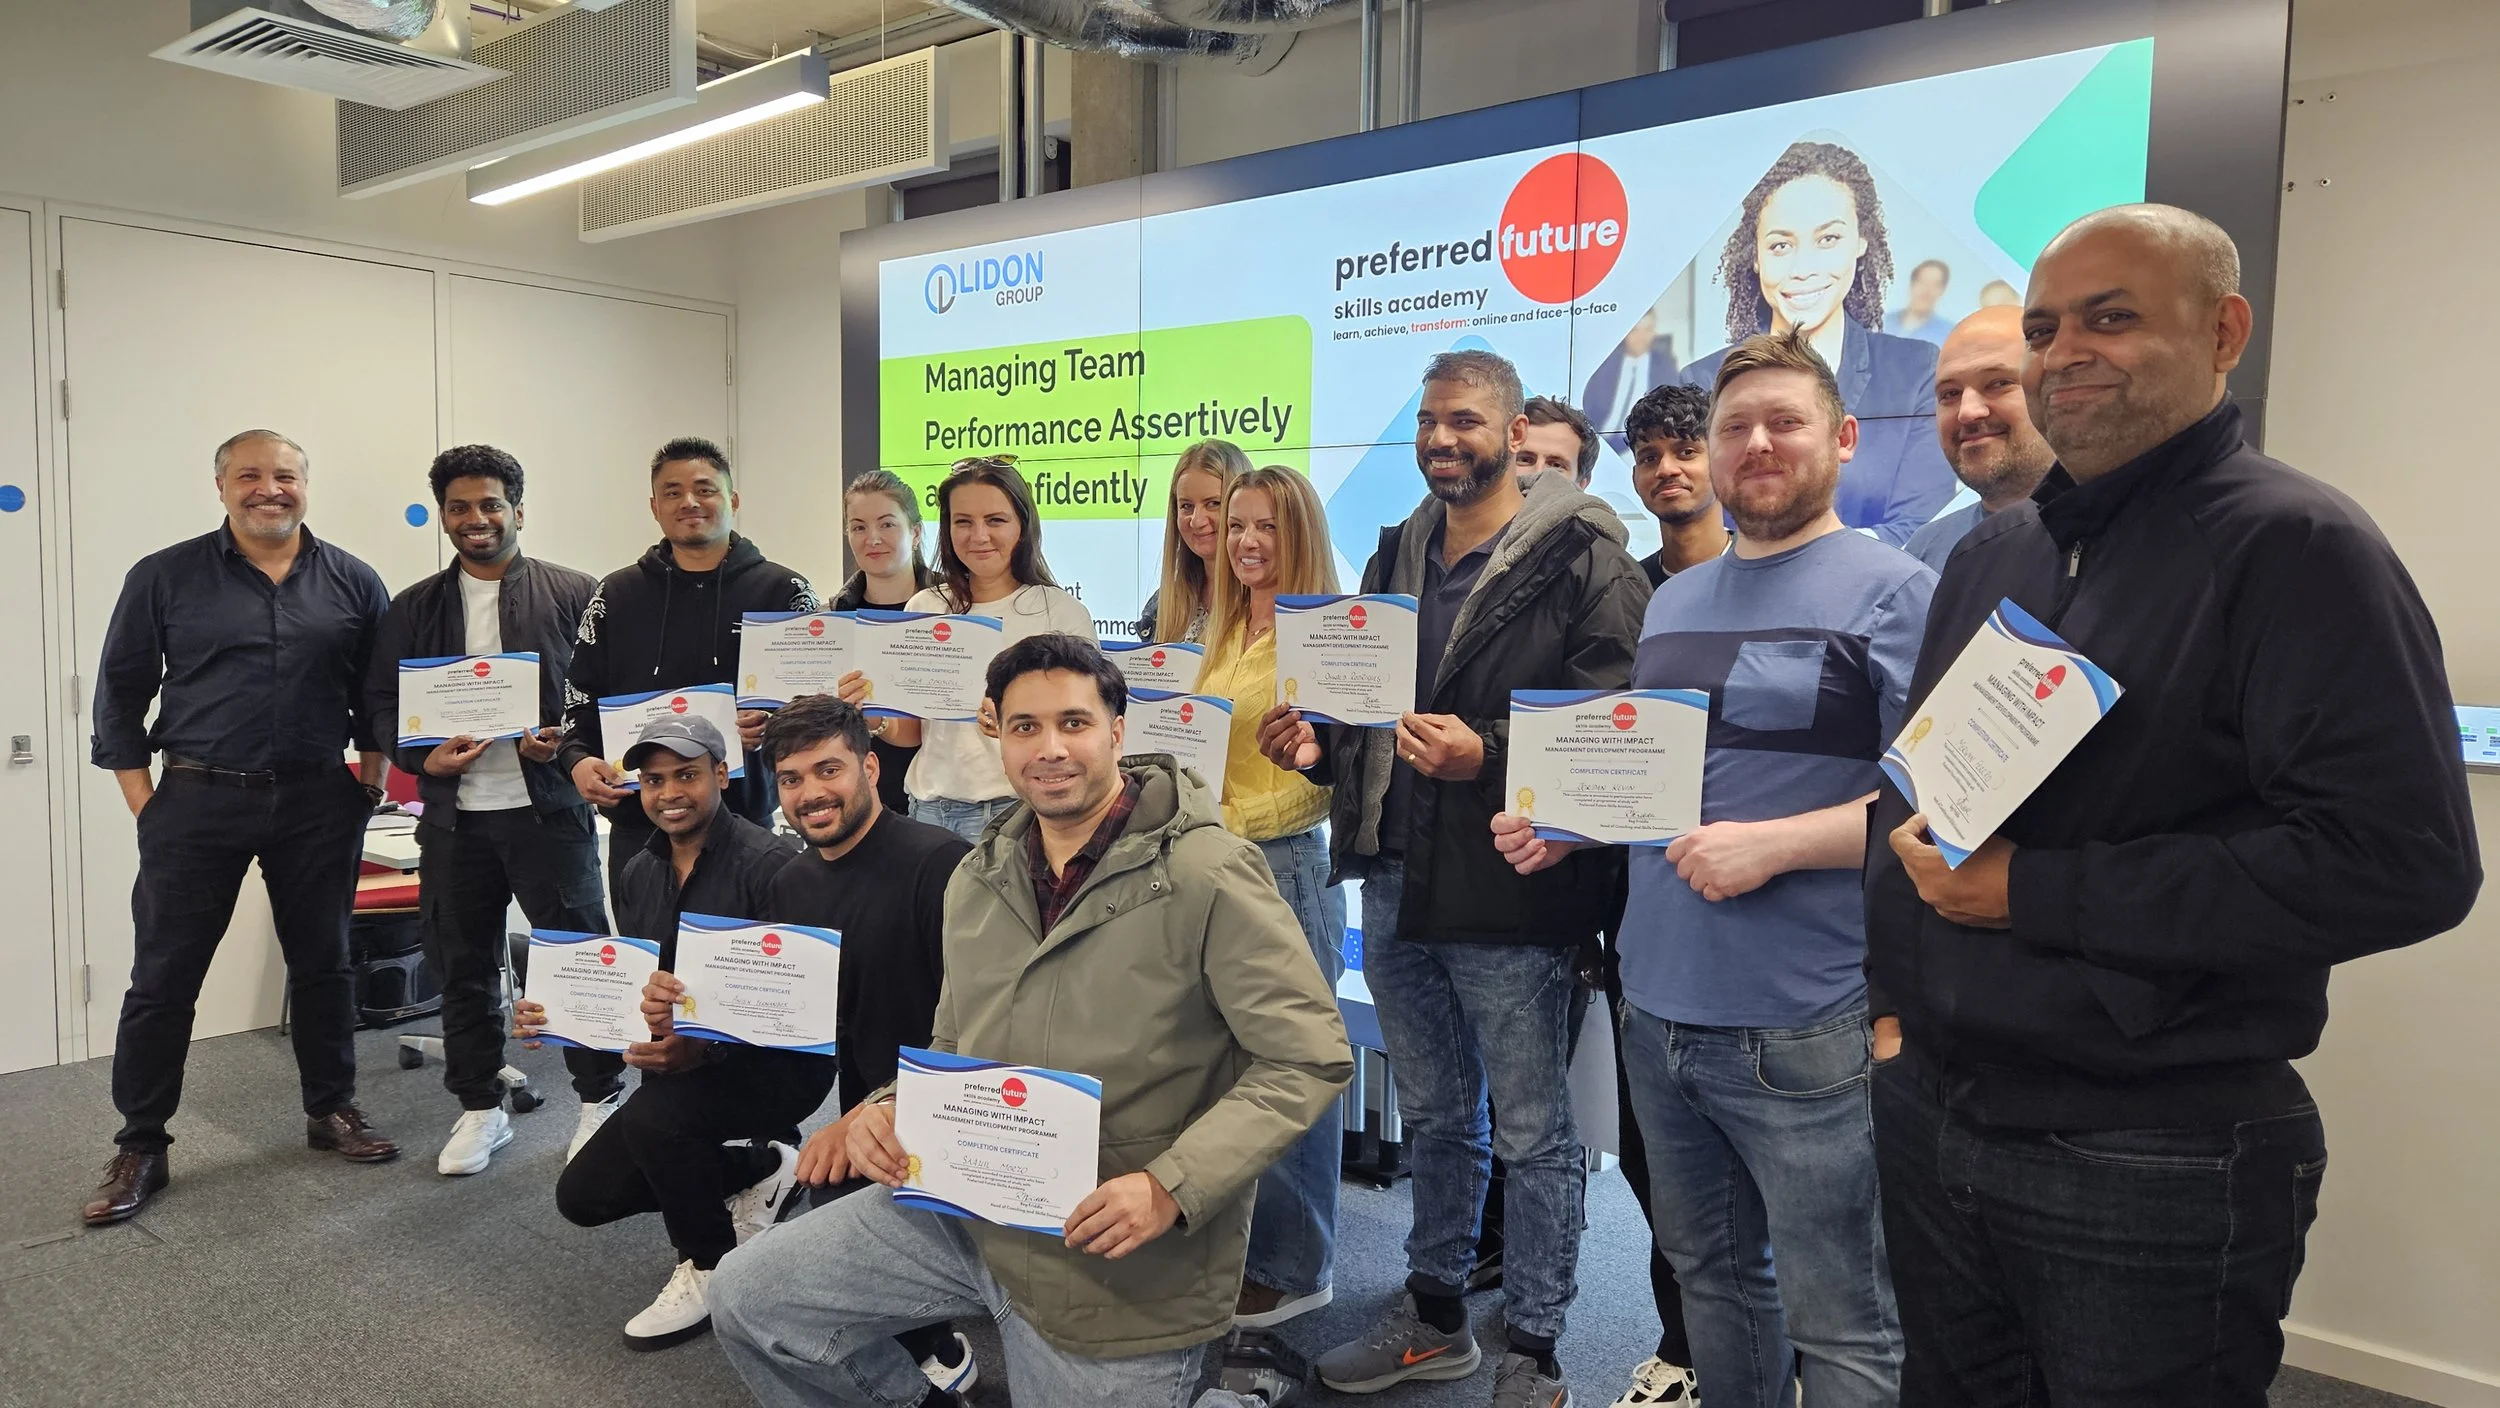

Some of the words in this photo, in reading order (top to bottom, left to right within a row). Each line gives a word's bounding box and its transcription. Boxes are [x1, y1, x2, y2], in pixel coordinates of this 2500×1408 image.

[1335, 230, 1492, 291] preferred
[1502, 219, 1620, 260] future
[960, 250, 1044, 294] LIDON
[996, 286, 1044, 306] GROUP
[1334, 298, 1382, 320] skills
[1388, 288, 1489, 314] academy
[1333, 326, 1362, 341] learn,
[1364, 323, 1409, 337] achieve,
[1411, 317, 1469, 333] transform:
[1472, 313, 1507, 327] online
[1510, 310, 1534, 323] and
[1536, 302, 1617, 320] face-to-face
[925, 354, 1057, 396] Managing
[1064, 348, 1145, 382] Team
[925, 418, 1101, 450] Performance
[1109, 396, 1293, 443] Assertively
[1028, 470, 1148, 513] fidently
[2019, 657, 2044, 680] preferred
[1987, 675, 2016, 704] MANAGING
[2012, 695, 2028, 713] WITH
[2026, 708, 2046, 729] IMPACT
[1576, 714, 1611, 722] preferred
[1143, 730, 1164, 738] MANAGEMENT
[1556, 736, 1600, 744] MANAGING
[731, 939, 760, 947] preferred
[705, 963, 738, 972] MANAGEMENT
[739, 967, 773, 976] DEVELOPMENT
[774, 971, 805, 979] PROGRAMME
[714, 955, 751, 965] MANAGING
[771, 962, 796, 970] IMPACT
[725, 983, 758, 992] COMPLETION
[759, 987, 790, 995] CERTIFICATE
[964, 1082, 1000, 1095] preferred
[1003, 1088, 1027, 1099] future
[933, 1113, 974, 1126] MANAGEMENT
[975, 1120, 1017, 1132] DEVELOPMENT
[1019, 1127, 1057, 1139] PROGRAMME
[944, 1104, 988, 1118] MANAGING
[991, 1111, 1012, 1121] WITH
[1014, 1116, 1045, 1126] IMPACT
[958, 1140, 998, 1152] COMPLETION
[1000, 1147, 1039, 1159] CERTIFICATE
